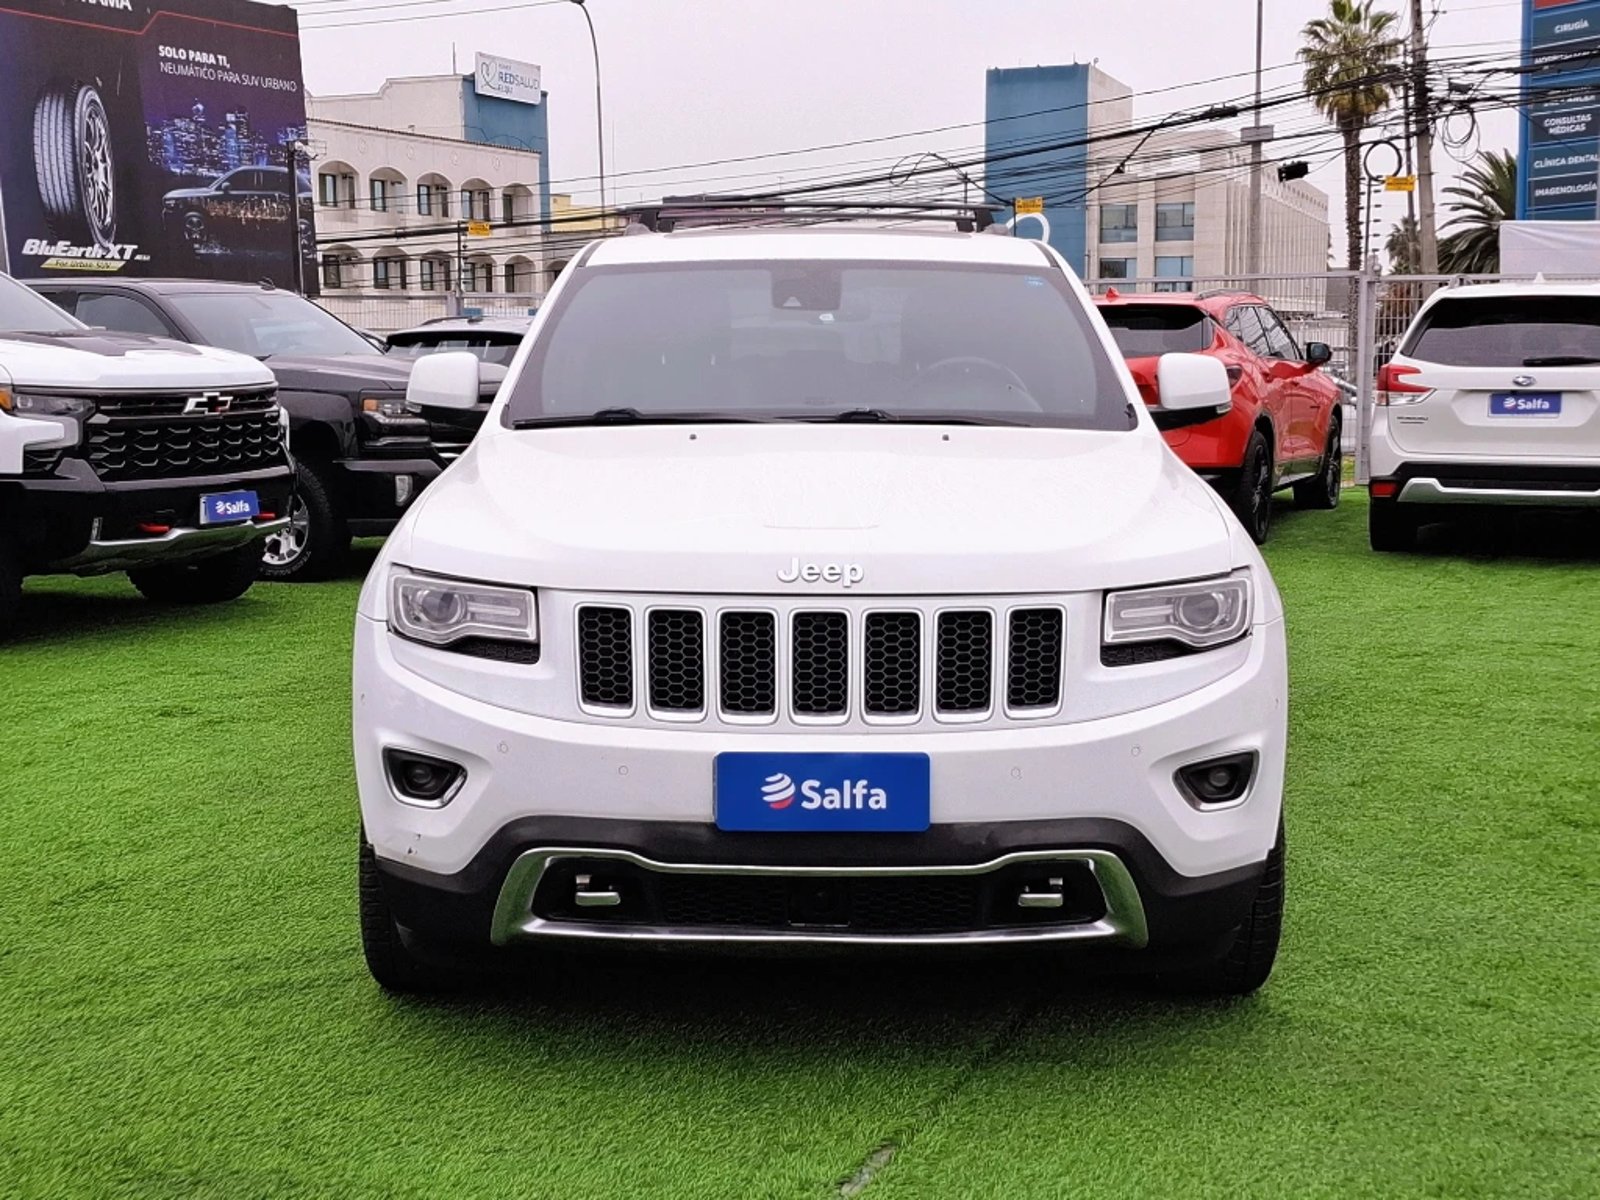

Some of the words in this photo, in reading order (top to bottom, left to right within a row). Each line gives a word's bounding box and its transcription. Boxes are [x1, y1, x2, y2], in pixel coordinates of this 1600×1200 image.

[1555, 18, 1589, 33] CIRUGÍA
[158, 45, 187, 60] SOLO
[188, 50, 216, 64] PARA
[216, 54, 230, 68] TI,
[159, 61, 216, 81] NEUMÁTICO
[217, 69, 241, 84] PARA
[241, 74, 260, 86] SUV
[260, 76, 298, 92] URBANO
[1544, 114, 1592, 126] CONSULTAS
[1549, 123, 1586, 134] MÉDICAS
[1534, 157, 1566, 168] CLÍNICA
[1567, 154, 1598, 165] DENTAL
[1534, 181, 1598, 197] IMAGENOLOGÍA
[1517, 398, 1550, 410] Salfa
[225, 500, 250, 515] Salfa
[776, 557, 865, 588] Jeep
[800, 779, 888, 810] Salfa
